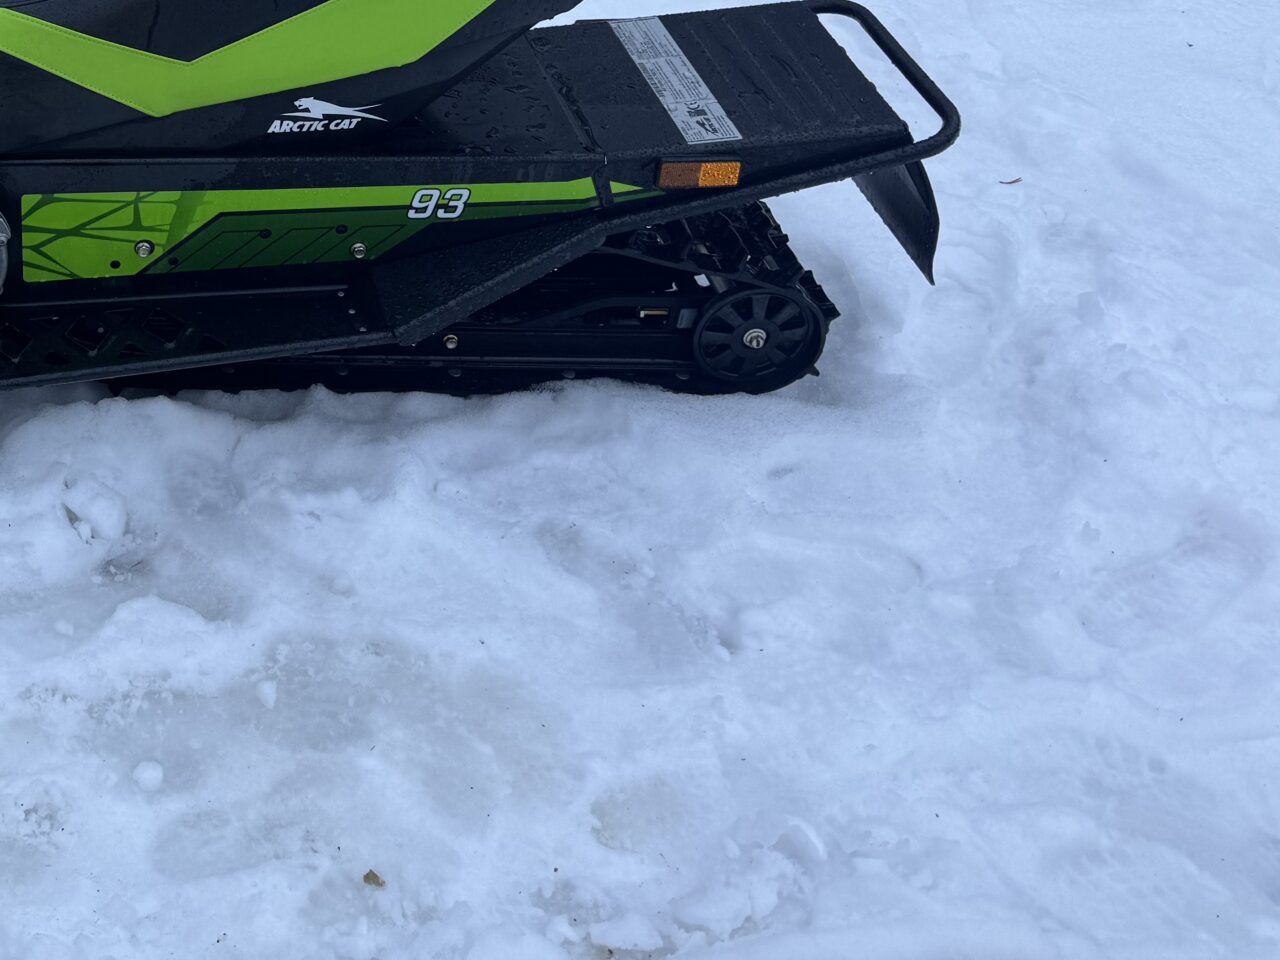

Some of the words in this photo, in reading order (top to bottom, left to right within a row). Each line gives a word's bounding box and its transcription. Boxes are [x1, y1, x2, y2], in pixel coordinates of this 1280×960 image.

[267, 119, 325, 133] ARCTIC
[329, 118, 361, 130] CAT
[406, 188, 471, 219] 93
